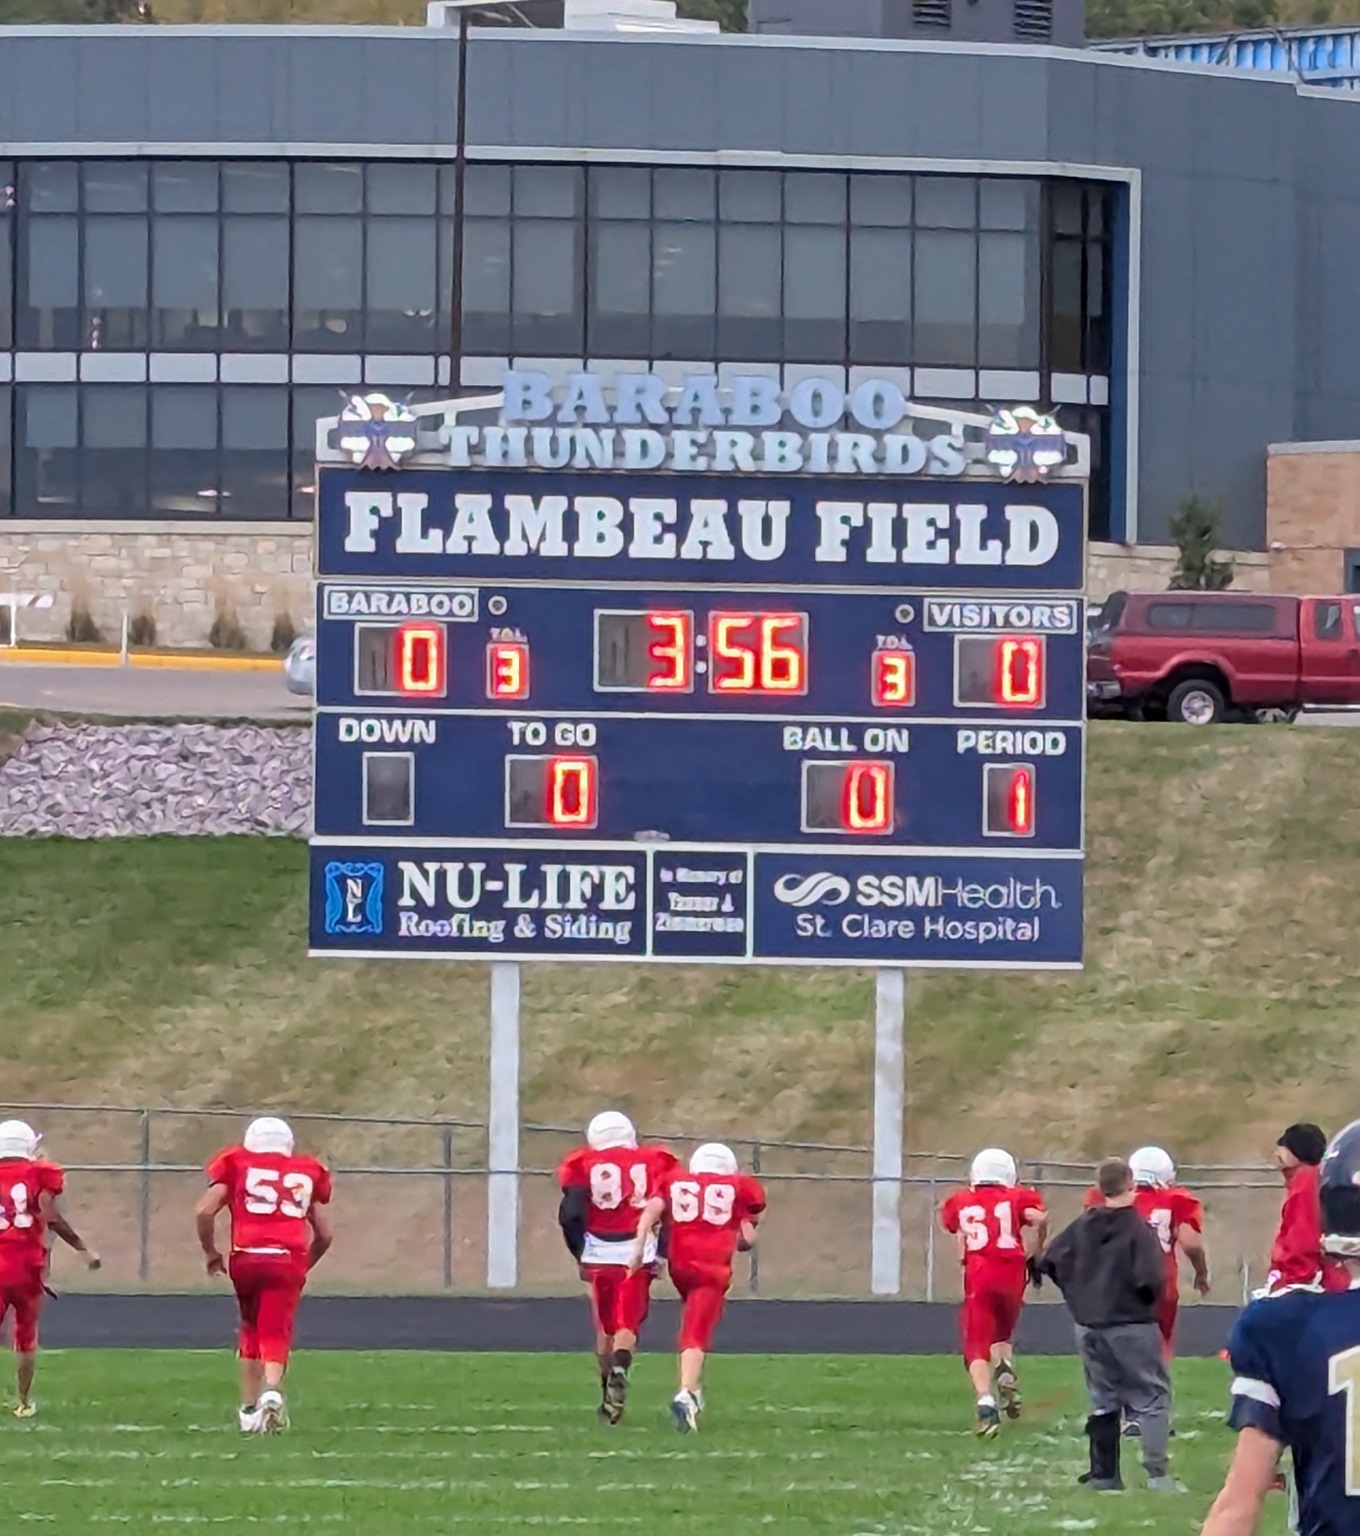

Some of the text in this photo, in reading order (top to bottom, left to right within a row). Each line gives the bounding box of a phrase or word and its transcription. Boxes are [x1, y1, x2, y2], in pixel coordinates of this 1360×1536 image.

[503, 370, 906, 429] BARABOO
[440, 424, 970, 477] THUNDERBIRDS
[344, 491, 1060, 566] FLAMBEAU FIELD
[329, 591, 475, 616] BARABOO
[929, 603, 1073, 628] VISITORS
[401, 628, 438, 692] 0
[496, 649, 521, 694] 3
[648, 615, 800, 691] 3:56
[1001, 639, 1038, 702] 0
[881, 656, 907, 701] 3
[338, 717, 437, 744] DOWN
[507, 720, 598, 747] TO GO
[783, 725, 909, 753] BALL ON
[956, 729, 1067, 757] PERIOD
[553, 761, 589, 823] 0
[849, 764, 887, 830] 0
[397, 861, 636, 911] NU-LIFE
[397, 911, 506, 944] Roofing
[513, 913, 537, 938] &
[544, 913, 633, 945] Siding
[841, 914, 915, 939] Clare
[923, 915, 1040, 944] Hospital
[244, 1167, 314, 1218] 53
[589, 1162, 650, 1211] 81
